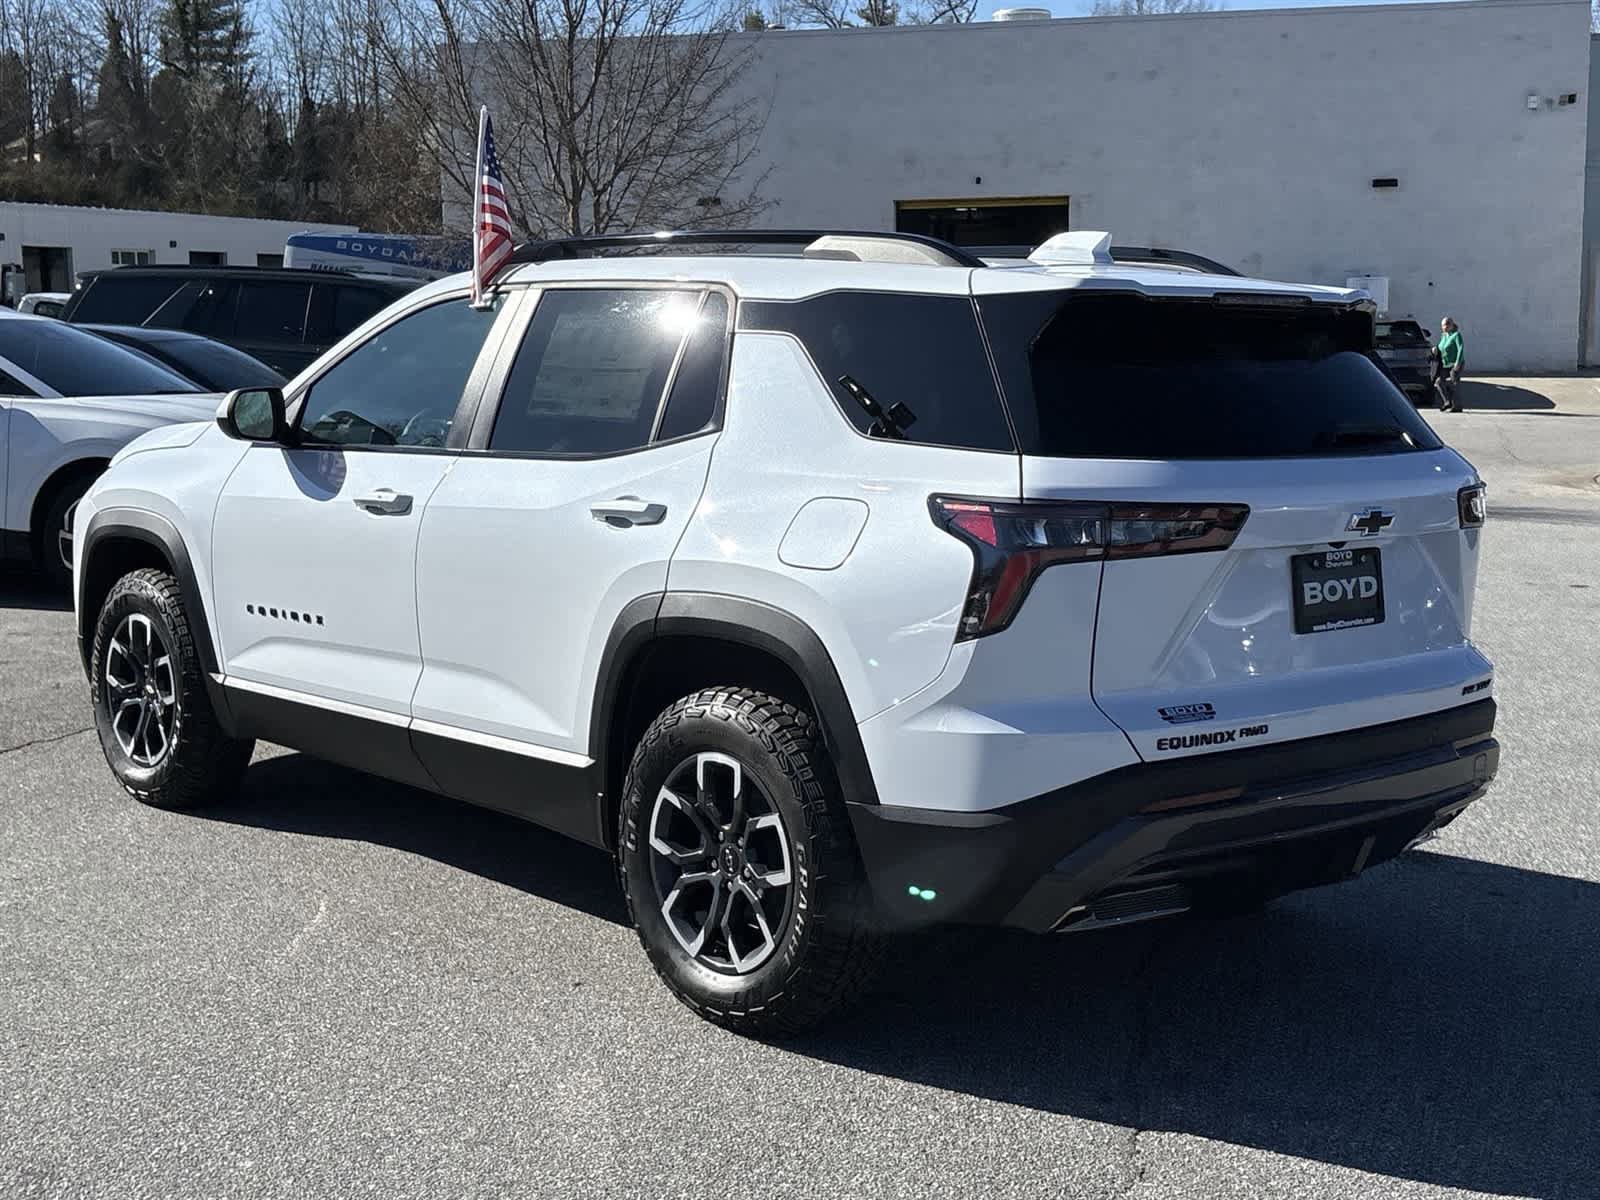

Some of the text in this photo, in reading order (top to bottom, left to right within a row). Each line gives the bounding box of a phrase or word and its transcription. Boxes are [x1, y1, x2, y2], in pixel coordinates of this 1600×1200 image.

[1326, 550, 1353, 561] BOYD
[1303, 575, 1378, 606] BOYD
[246, 604, 324, 627] EQUINOX
[1156, 724, 1269, 751] EQUINOX AWD
